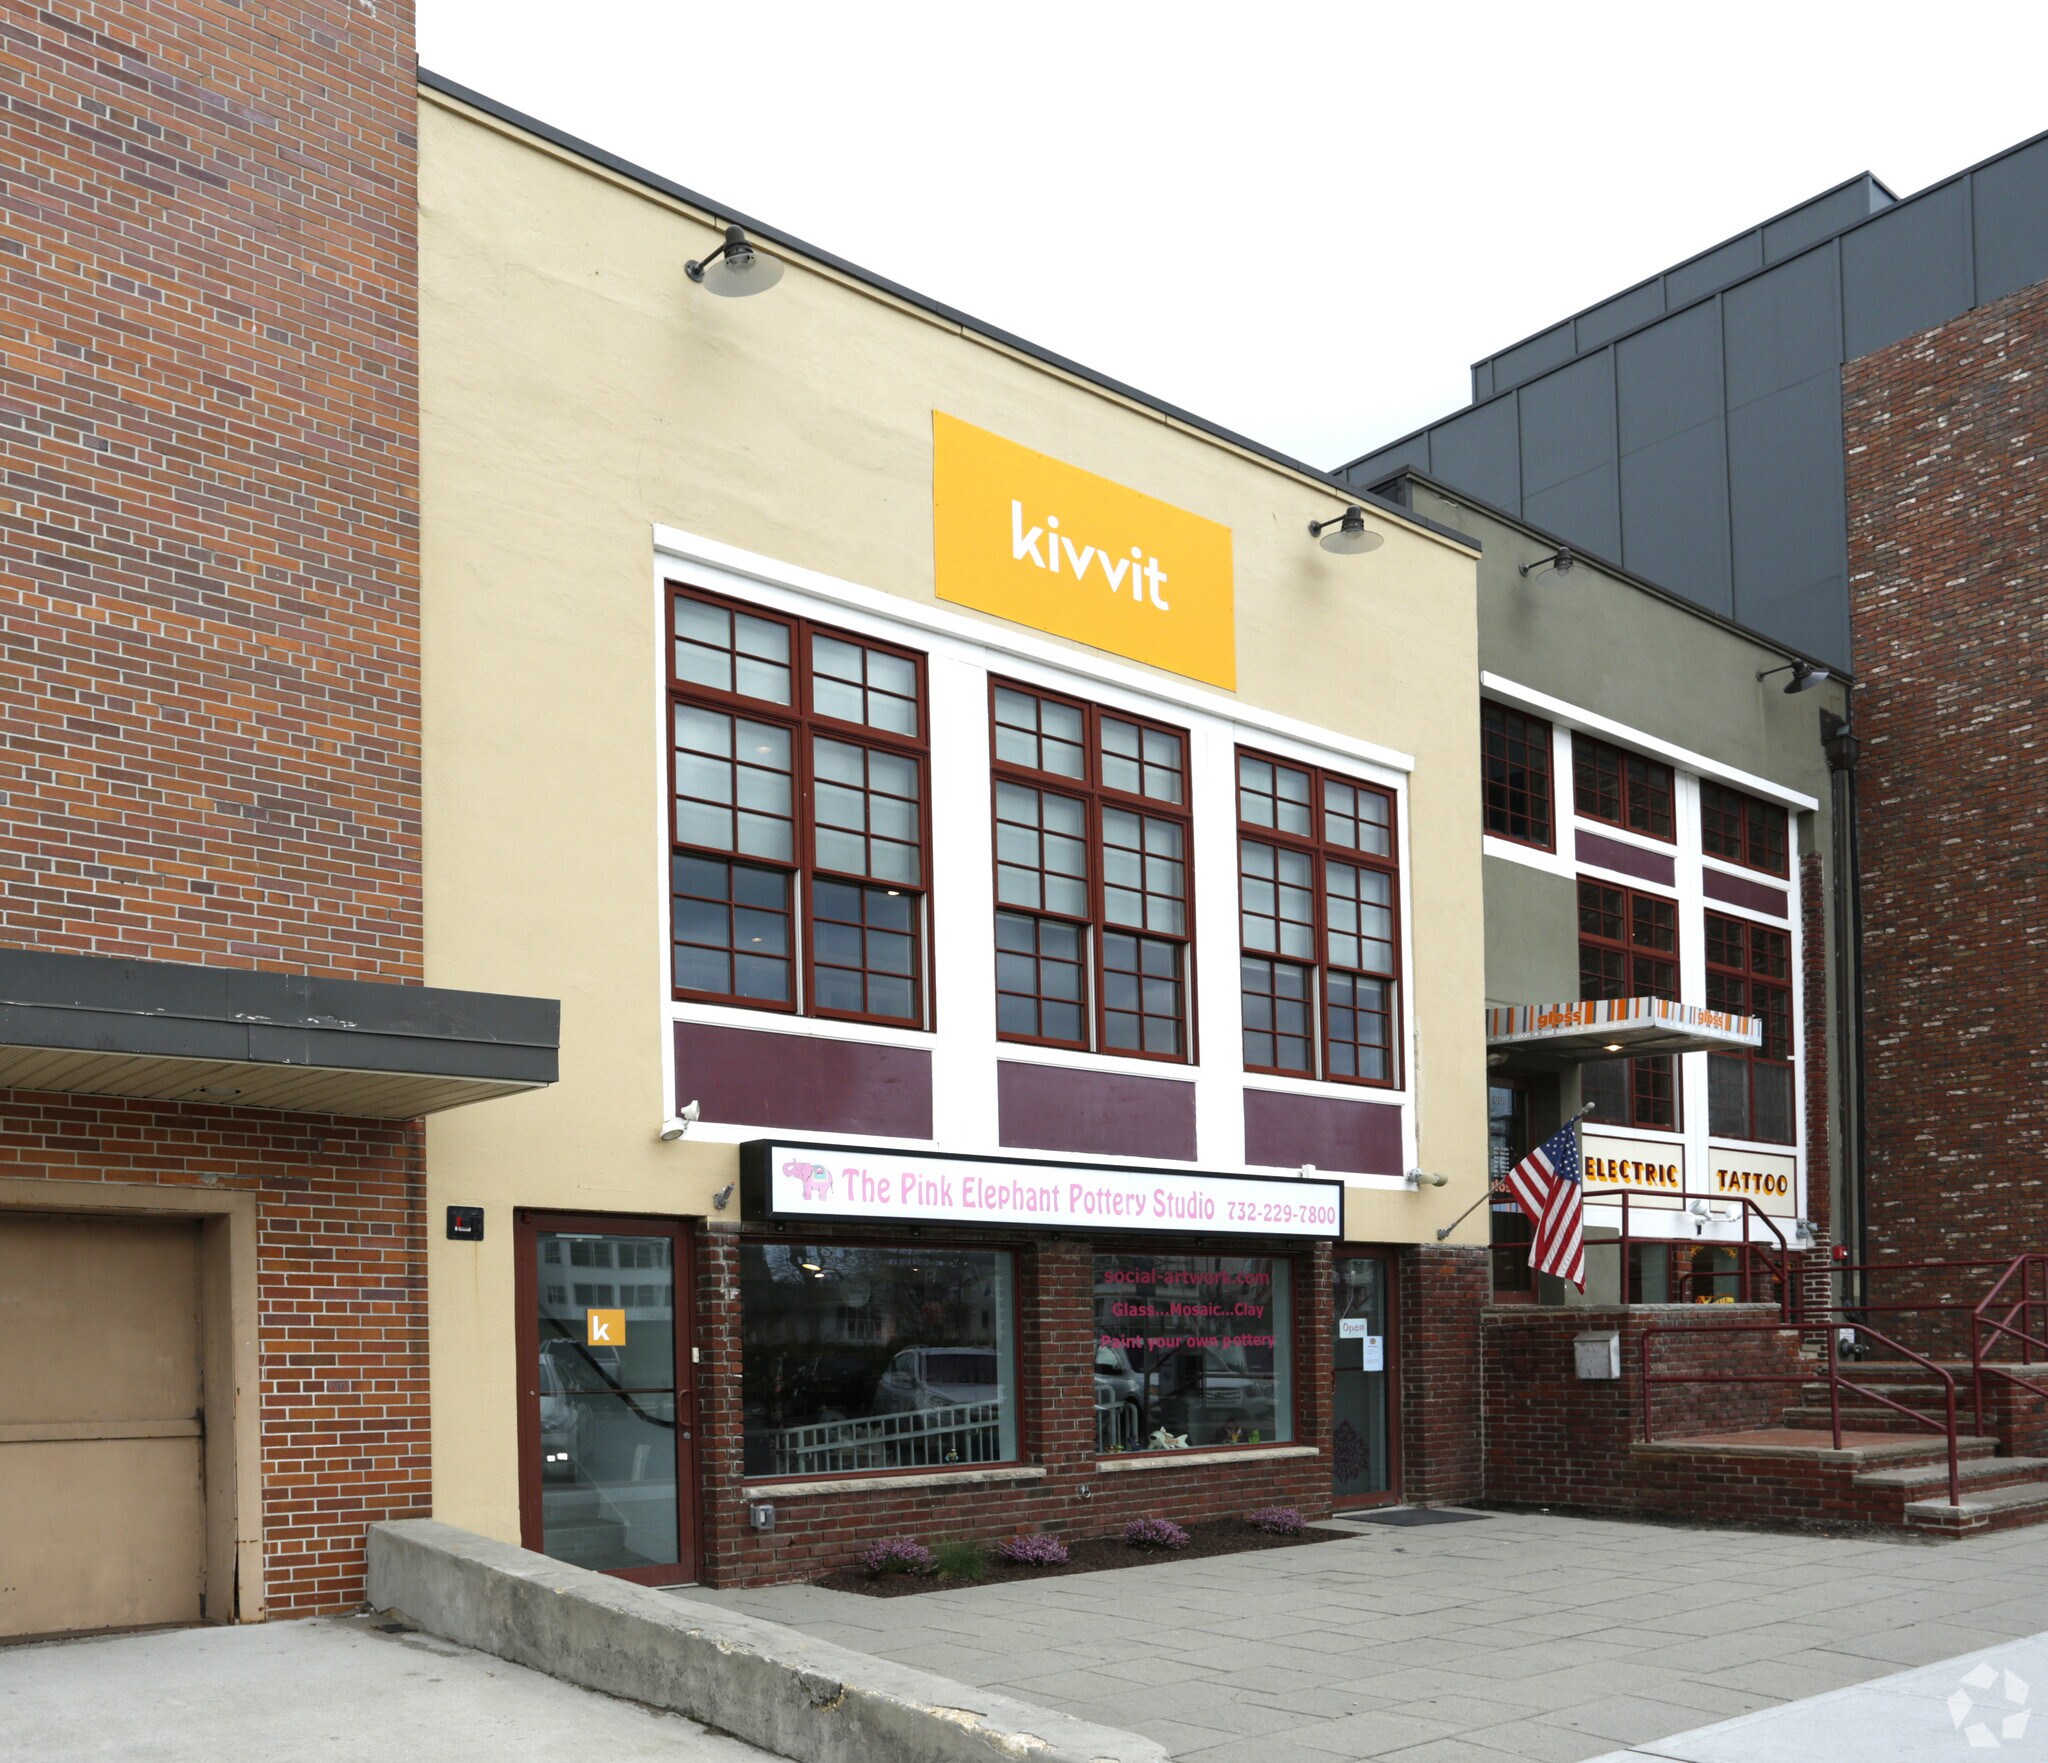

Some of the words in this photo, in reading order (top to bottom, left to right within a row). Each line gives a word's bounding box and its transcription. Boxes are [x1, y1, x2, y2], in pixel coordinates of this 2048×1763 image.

[1011, 499, 1169, 611] kivvit
[1537, 1010, 1582, 1029] gloss
[1697, 1009, 1723, 1027] gloss
[1512, 1032, 1531, 1040] salon
[1541, 1028, 1555, 1036] nail
[1556, 1026, 1576, 1034] salon
[1584, 1155, 1678, 1187] ELECTRIC
[1717, 1168, 1788, 1196] TATTOO
[842, 1167, 891, 1204] The
[901, 1172, 954, 1207] Pink
[962, 1174, 1060, 1213] Elephant
[1069, 1183, 1147, 1217] Pottery
[1153, 1187, 1215, 1221] Studio
[1227, 1201, 1336, 1225] 732-229-7800
[1104, 1268, 1270, 1285] social-artwork.com
[592, 1315, 610, 1341] k
[1343, 1322, 1365, 1334] Open
[1101, 1334, 1143, 1350] Paint
[1148, 1336, 1182, 1351] your
[1187, 1335, 1218, 1348] own
[1222, 1333, 1275, 1350] pottery
